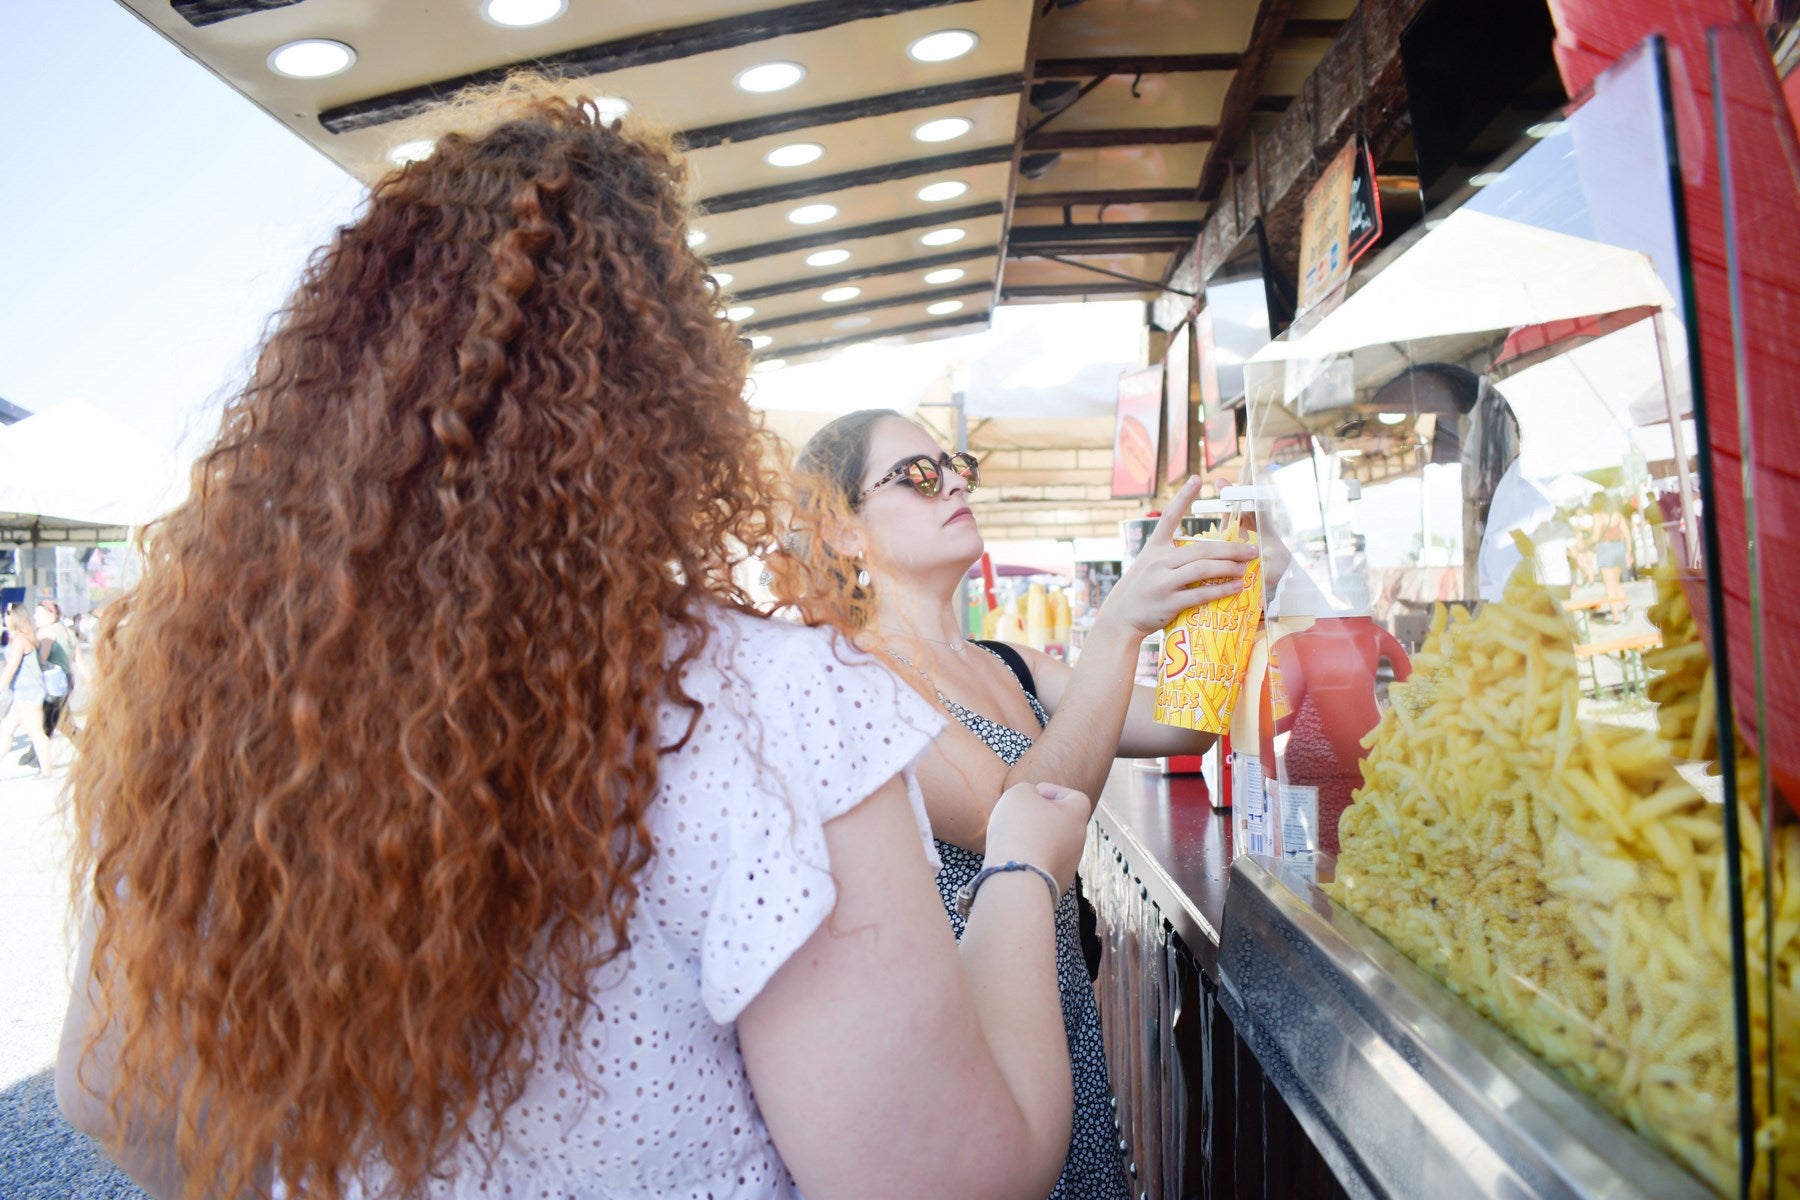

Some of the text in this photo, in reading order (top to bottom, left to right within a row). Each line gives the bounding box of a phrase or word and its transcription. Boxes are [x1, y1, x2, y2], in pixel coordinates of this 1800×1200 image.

[1185, 607, 1239, 631] CHIPS
[1184, 659, 1234, 681] CHIPS
[1157, 687, 1200, 709] CHIPS
